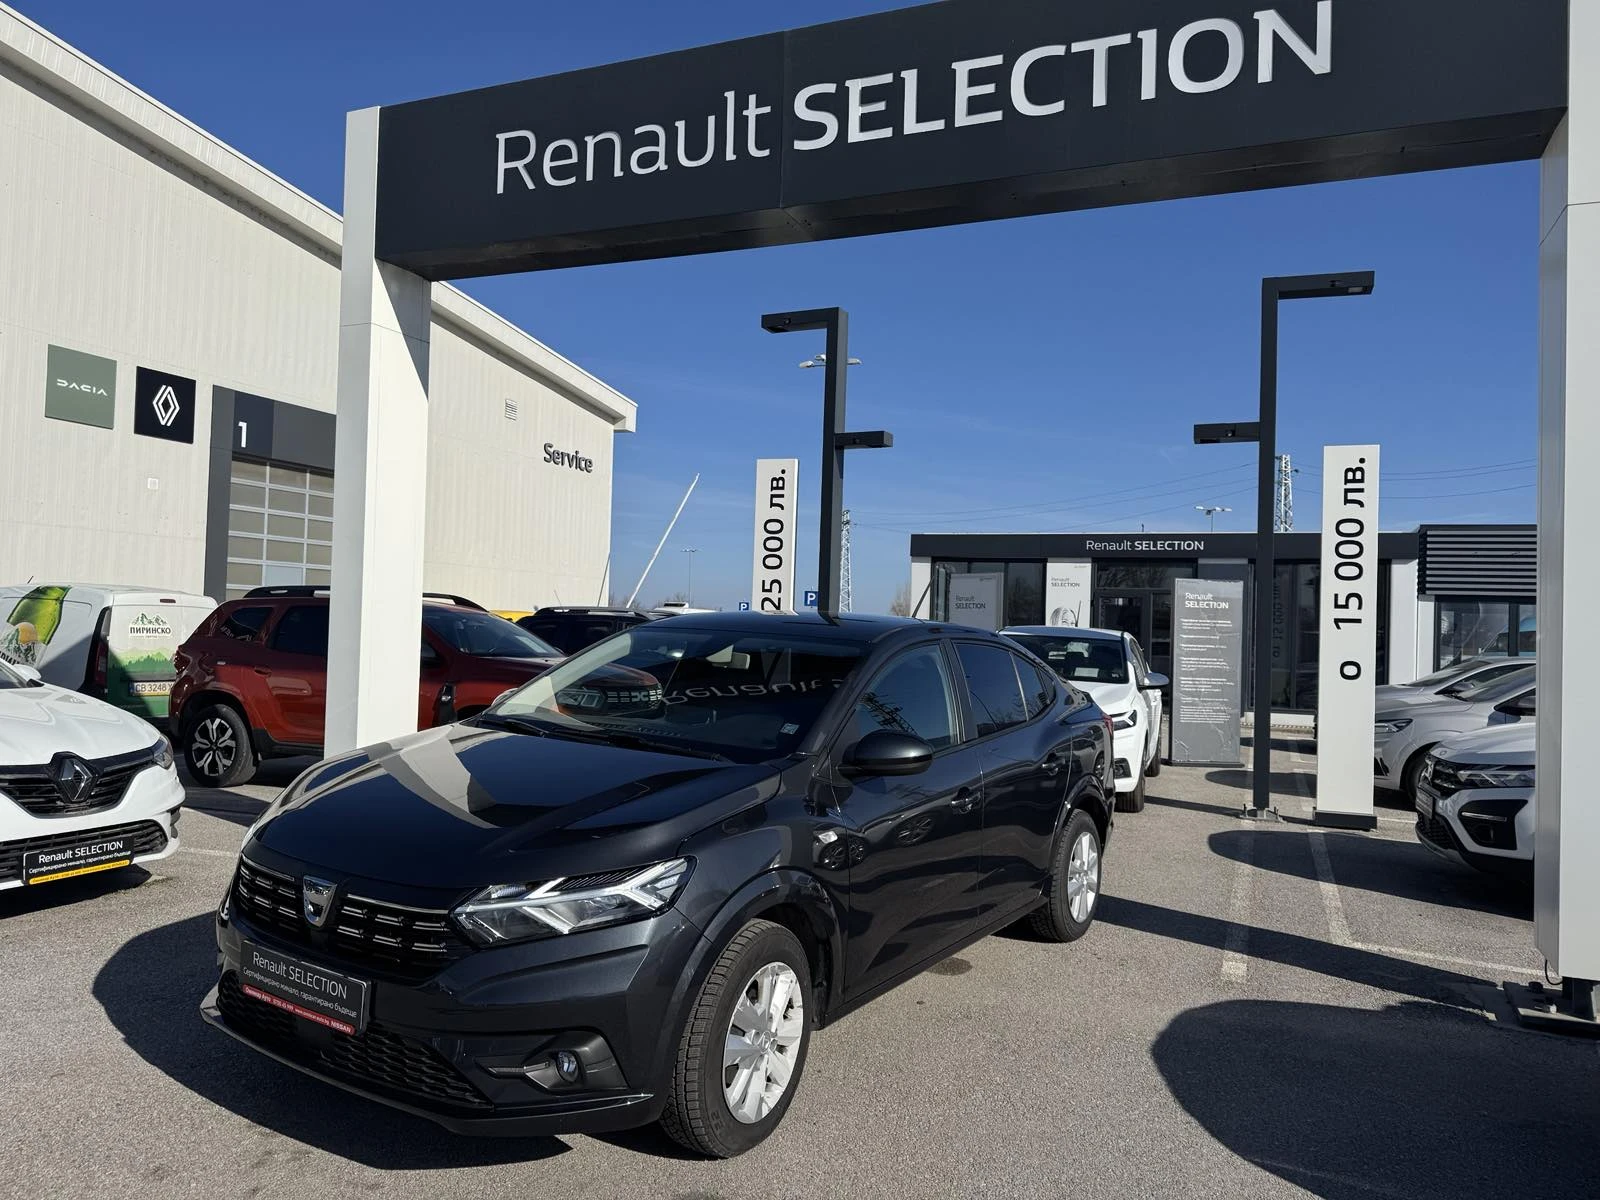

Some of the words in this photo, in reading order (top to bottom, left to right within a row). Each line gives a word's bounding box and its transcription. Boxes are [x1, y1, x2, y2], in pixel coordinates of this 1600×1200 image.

[496, 90, 772, 195] Renault
[793, 0, 1333, 152] SELECTION
[56, 378, 108, 397] DACIA
[238, 421, 247, 448] 1
[543, 442, 593, 474] Service
[769, 468, 786, 511] лв.
[1343, 457, 1366, 508] лв.
[762, 518, 785, 570] 000
[1086, 540, 1132, 551] Renault
[1134, 540, 1204, 551] SELECTION
[1334, 517, 1365, 581] 000
[740, 602, 748, 611] P
[760, 578, 783, 611] 25
[807, 593, 816, 605] P
[954, 602, 986, 610] SELECTION
[1185, 592, 1213, 601] Renault
[1185, 601, 1229, 609] SELECTION
[1333, 592, 1363, 630] 15
[130, 626, 172, 635] ПИРИНСКО
[148, 683, 166, 692] 3248
[38, 849, 73, 864] Renault
[74, 840, 124, 858] SELECTION
[253, 951, 287, 978] Renault
[288, 965, 347, 1000] SELECTION
